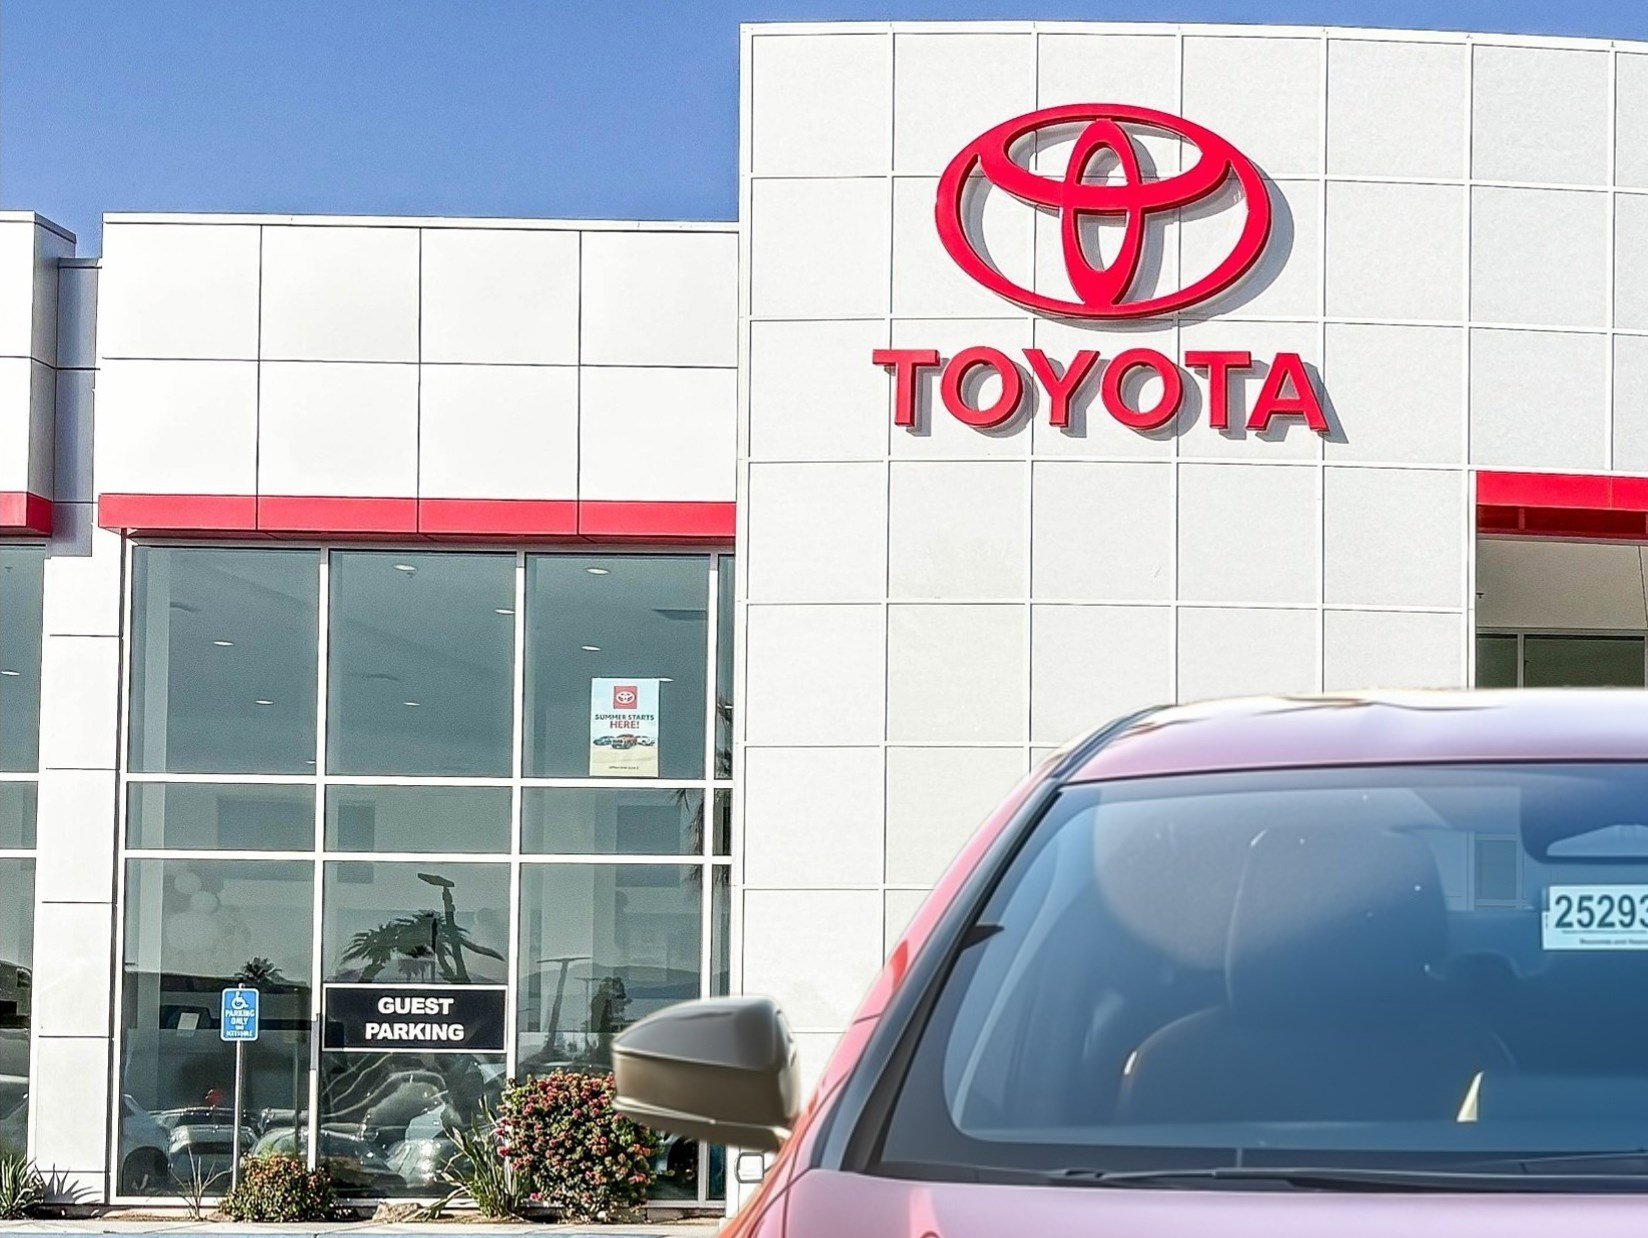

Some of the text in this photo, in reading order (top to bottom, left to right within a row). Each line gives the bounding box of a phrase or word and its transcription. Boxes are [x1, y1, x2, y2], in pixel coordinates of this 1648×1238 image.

[872, 346, 1330, 433] TOYOTA
[594, 713, 655, 721] SUMMER STARTS
[609, 720, 640, 730] HERE!
[225, 1009, 255, 1017] PARKING
[377, 996, 455, 1016] GUEST
[365, 1022, 465, 1042] PARKING
